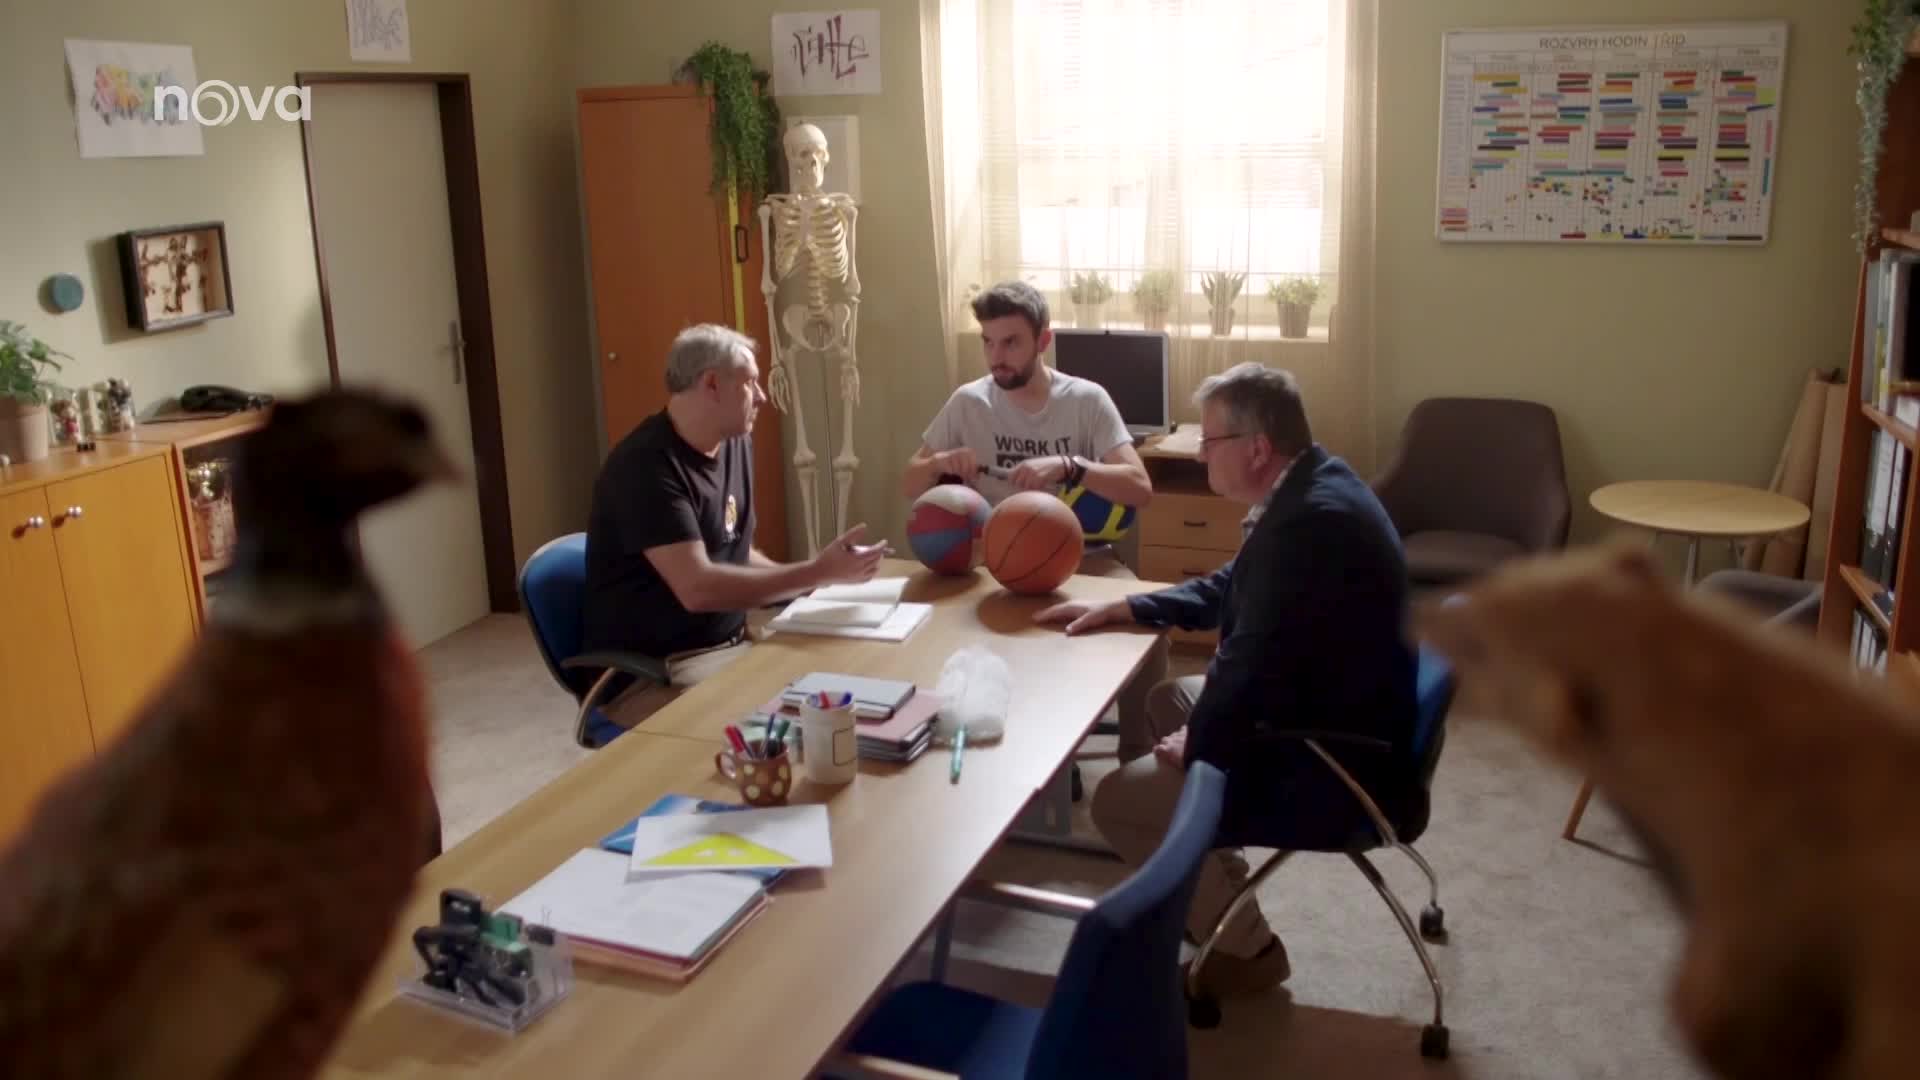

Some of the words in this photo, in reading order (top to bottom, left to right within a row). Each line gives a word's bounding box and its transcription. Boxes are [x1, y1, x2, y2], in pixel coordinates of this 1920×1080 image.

[1540, 36, 1598, 49] ROZVRH
[1602, 34, 1648, 48] HODIN
[995, 435, 1050, 456] WORK
[1054, 435, 1071, 455] IT
